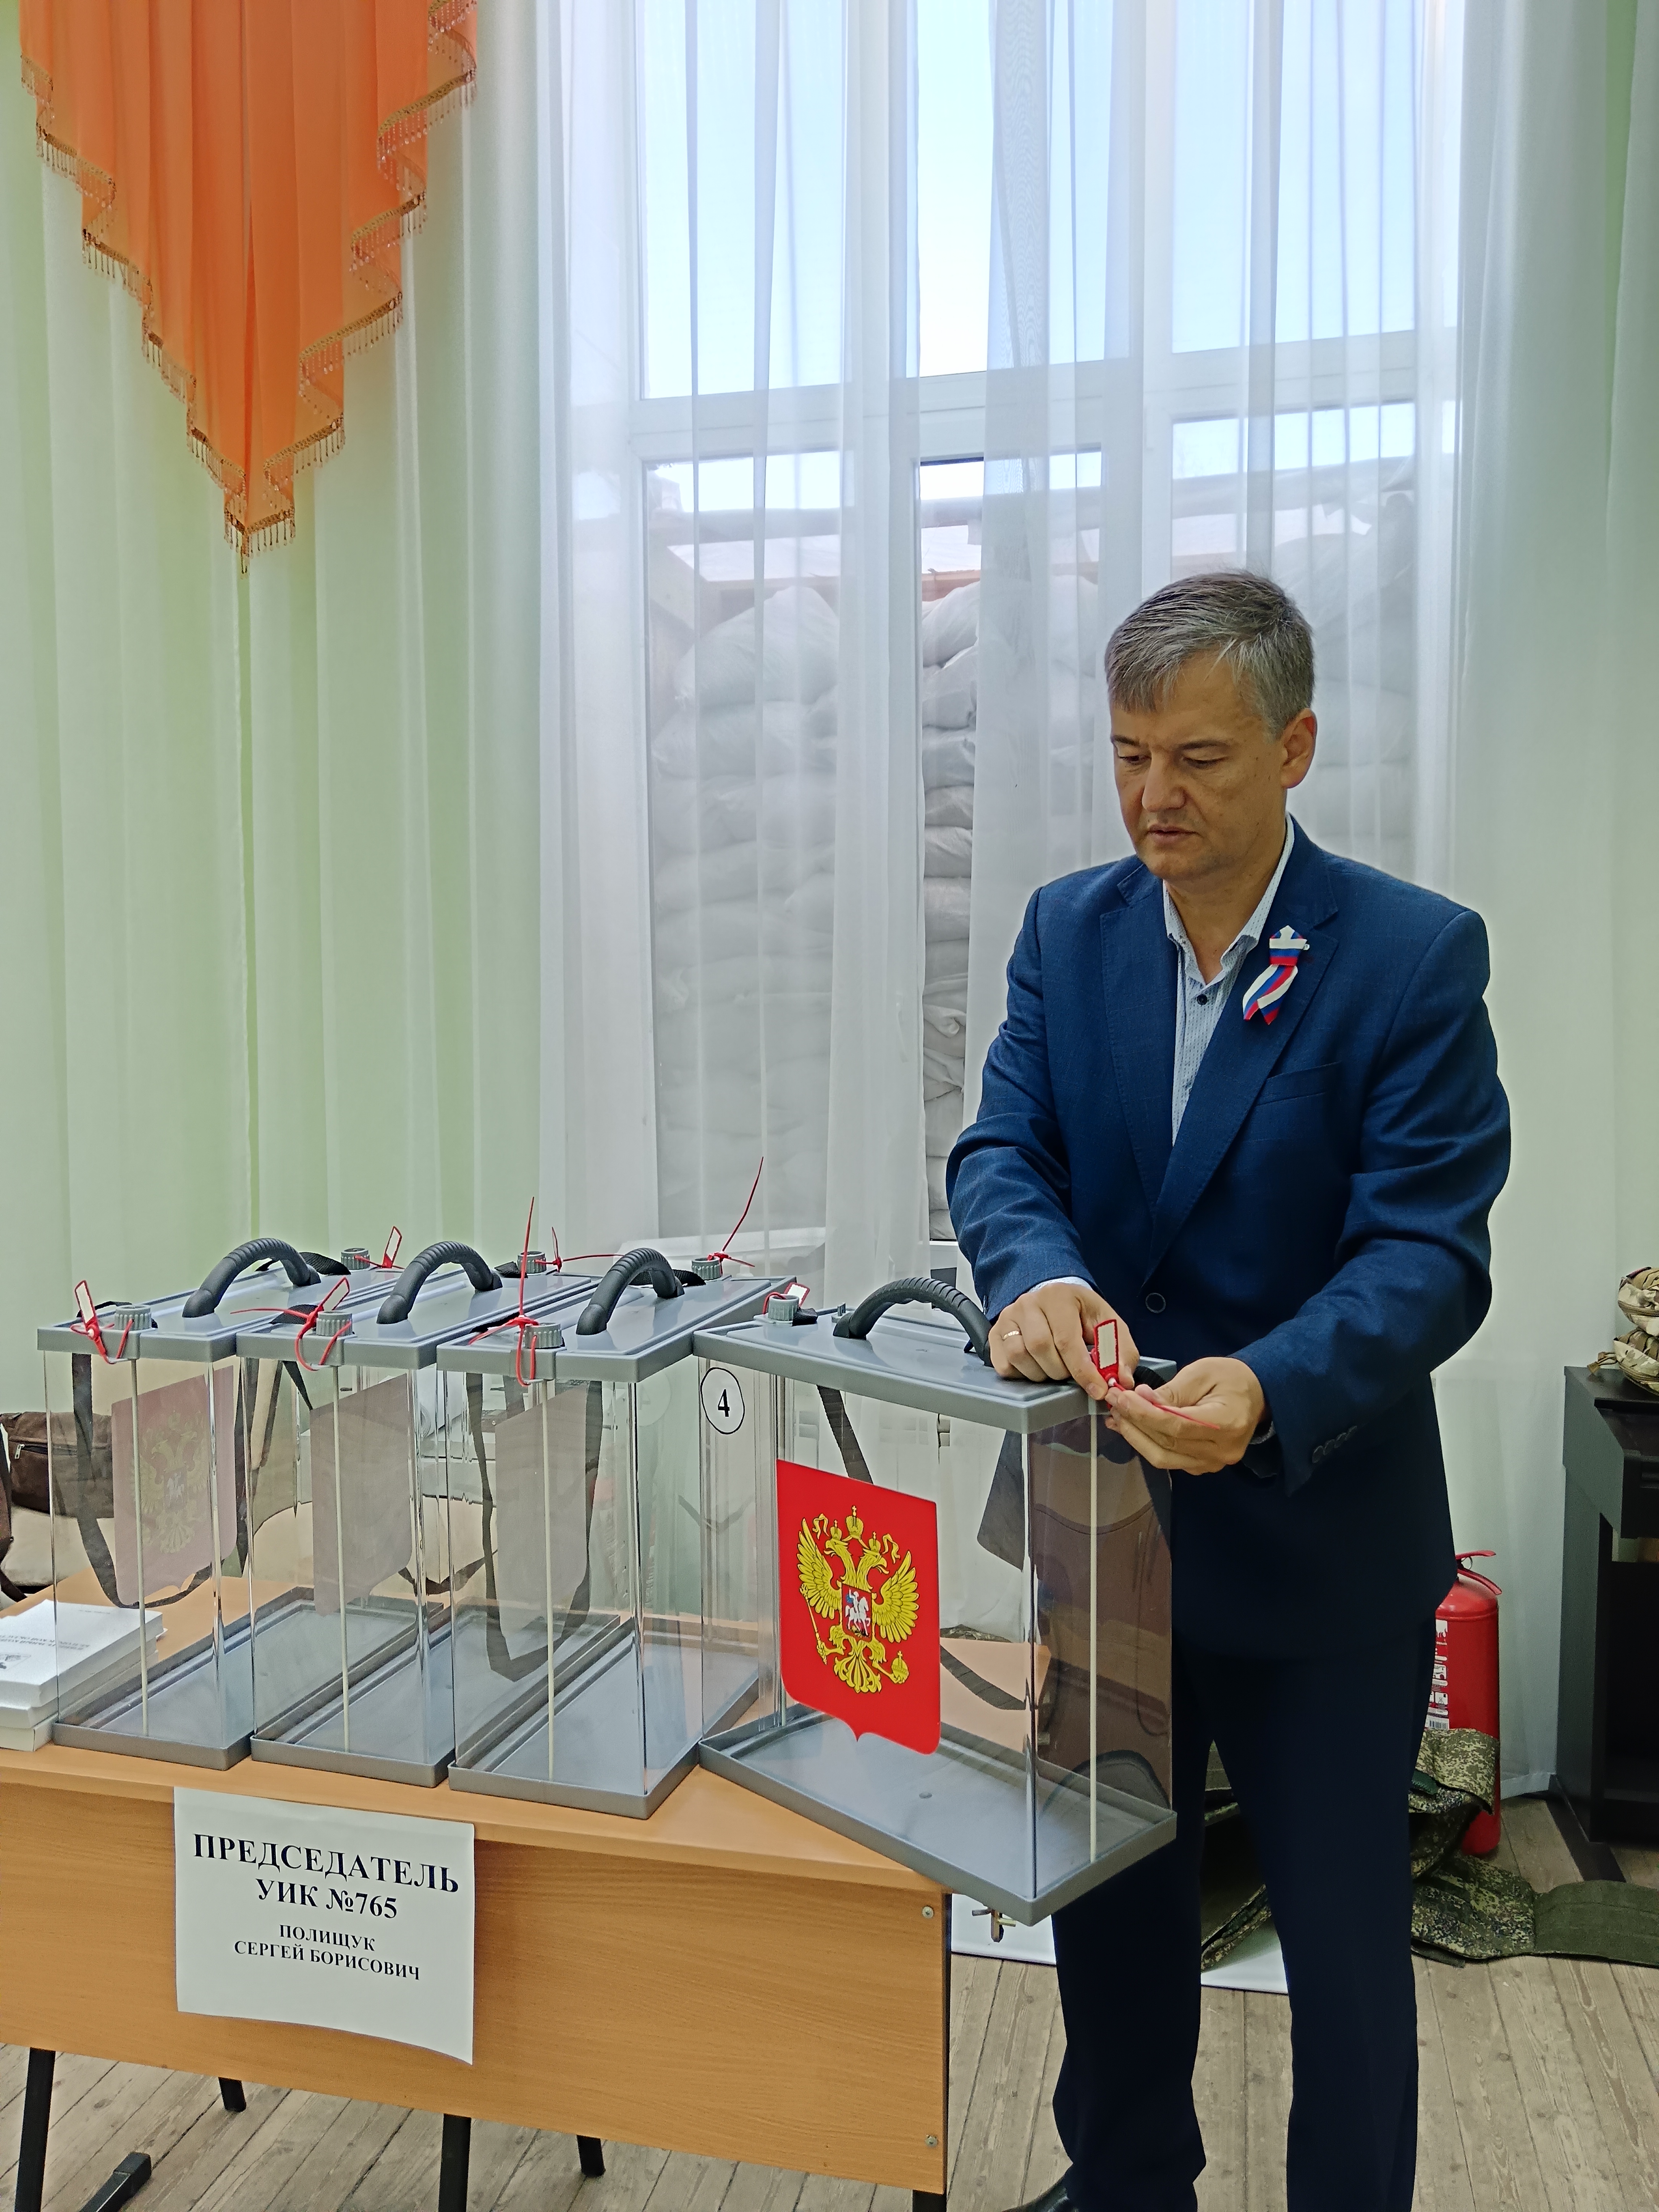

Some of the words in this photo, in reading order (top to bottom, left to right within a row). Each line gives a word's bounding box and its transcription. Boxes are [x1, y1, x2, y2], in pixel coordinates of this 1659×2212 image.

[718, 1389, 730, 1417] 4
[194, 1834, 458, 1892] ПРЕДСЕДАТЕЛЬ
[255, 1878, 318, 1907] УИК
[326, 1888, 397, 1919] №765
[280, 1924, 375, 1951] ПОЛИЩУК
[234, 1941, 304, 1960] СЕРГЕЙ
[310, 1949, 419, 1980] БОРИСОВИЧ
